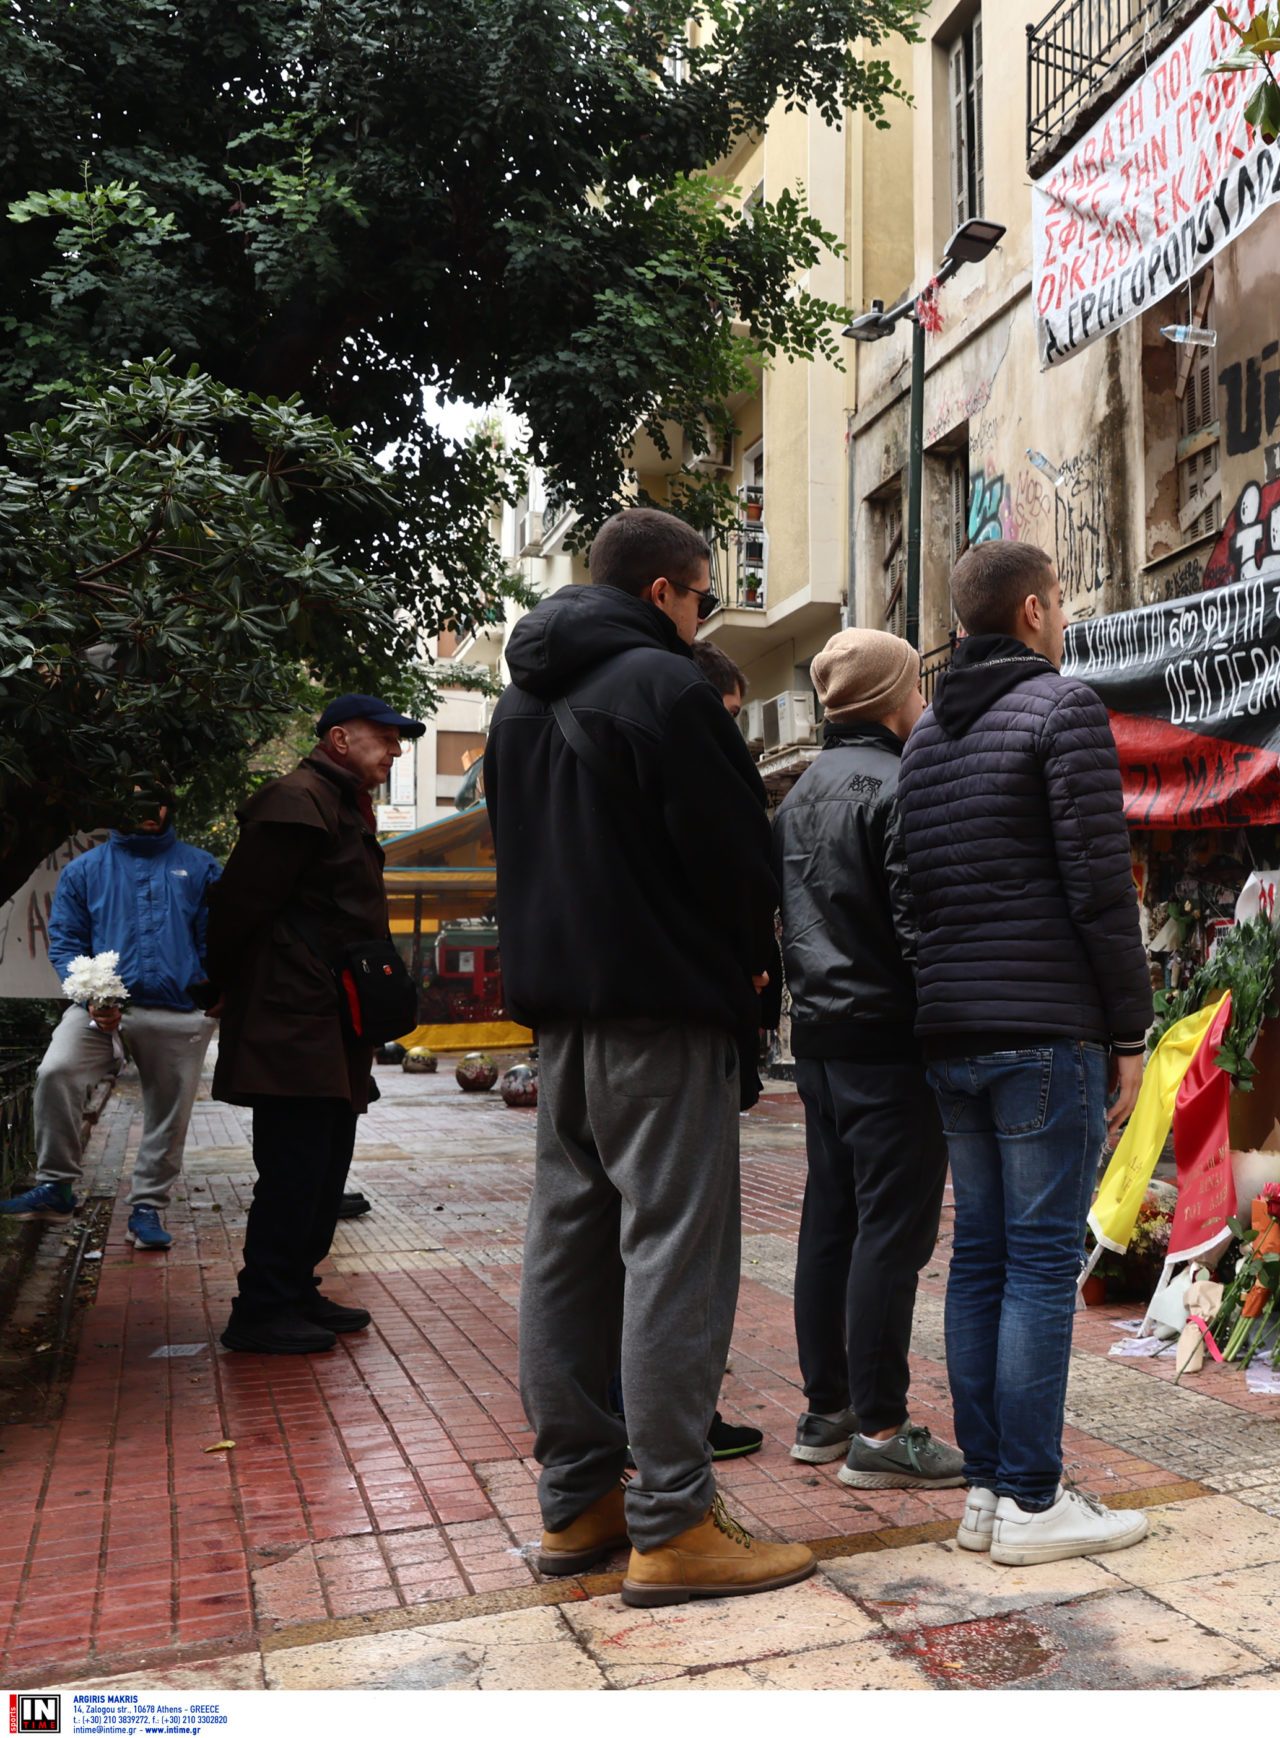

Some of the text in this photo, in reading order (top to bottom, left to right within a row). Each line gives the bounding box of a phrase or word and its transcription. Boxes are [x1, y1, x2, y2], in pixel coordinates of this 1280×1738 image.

[1153, 33, 1195, 120] ΠΟΥ
[1120, 135, 1168, 203] ΤΗΝ
[1037, 205, 1144, 315] ΟΡΚΙΣΟΥ
